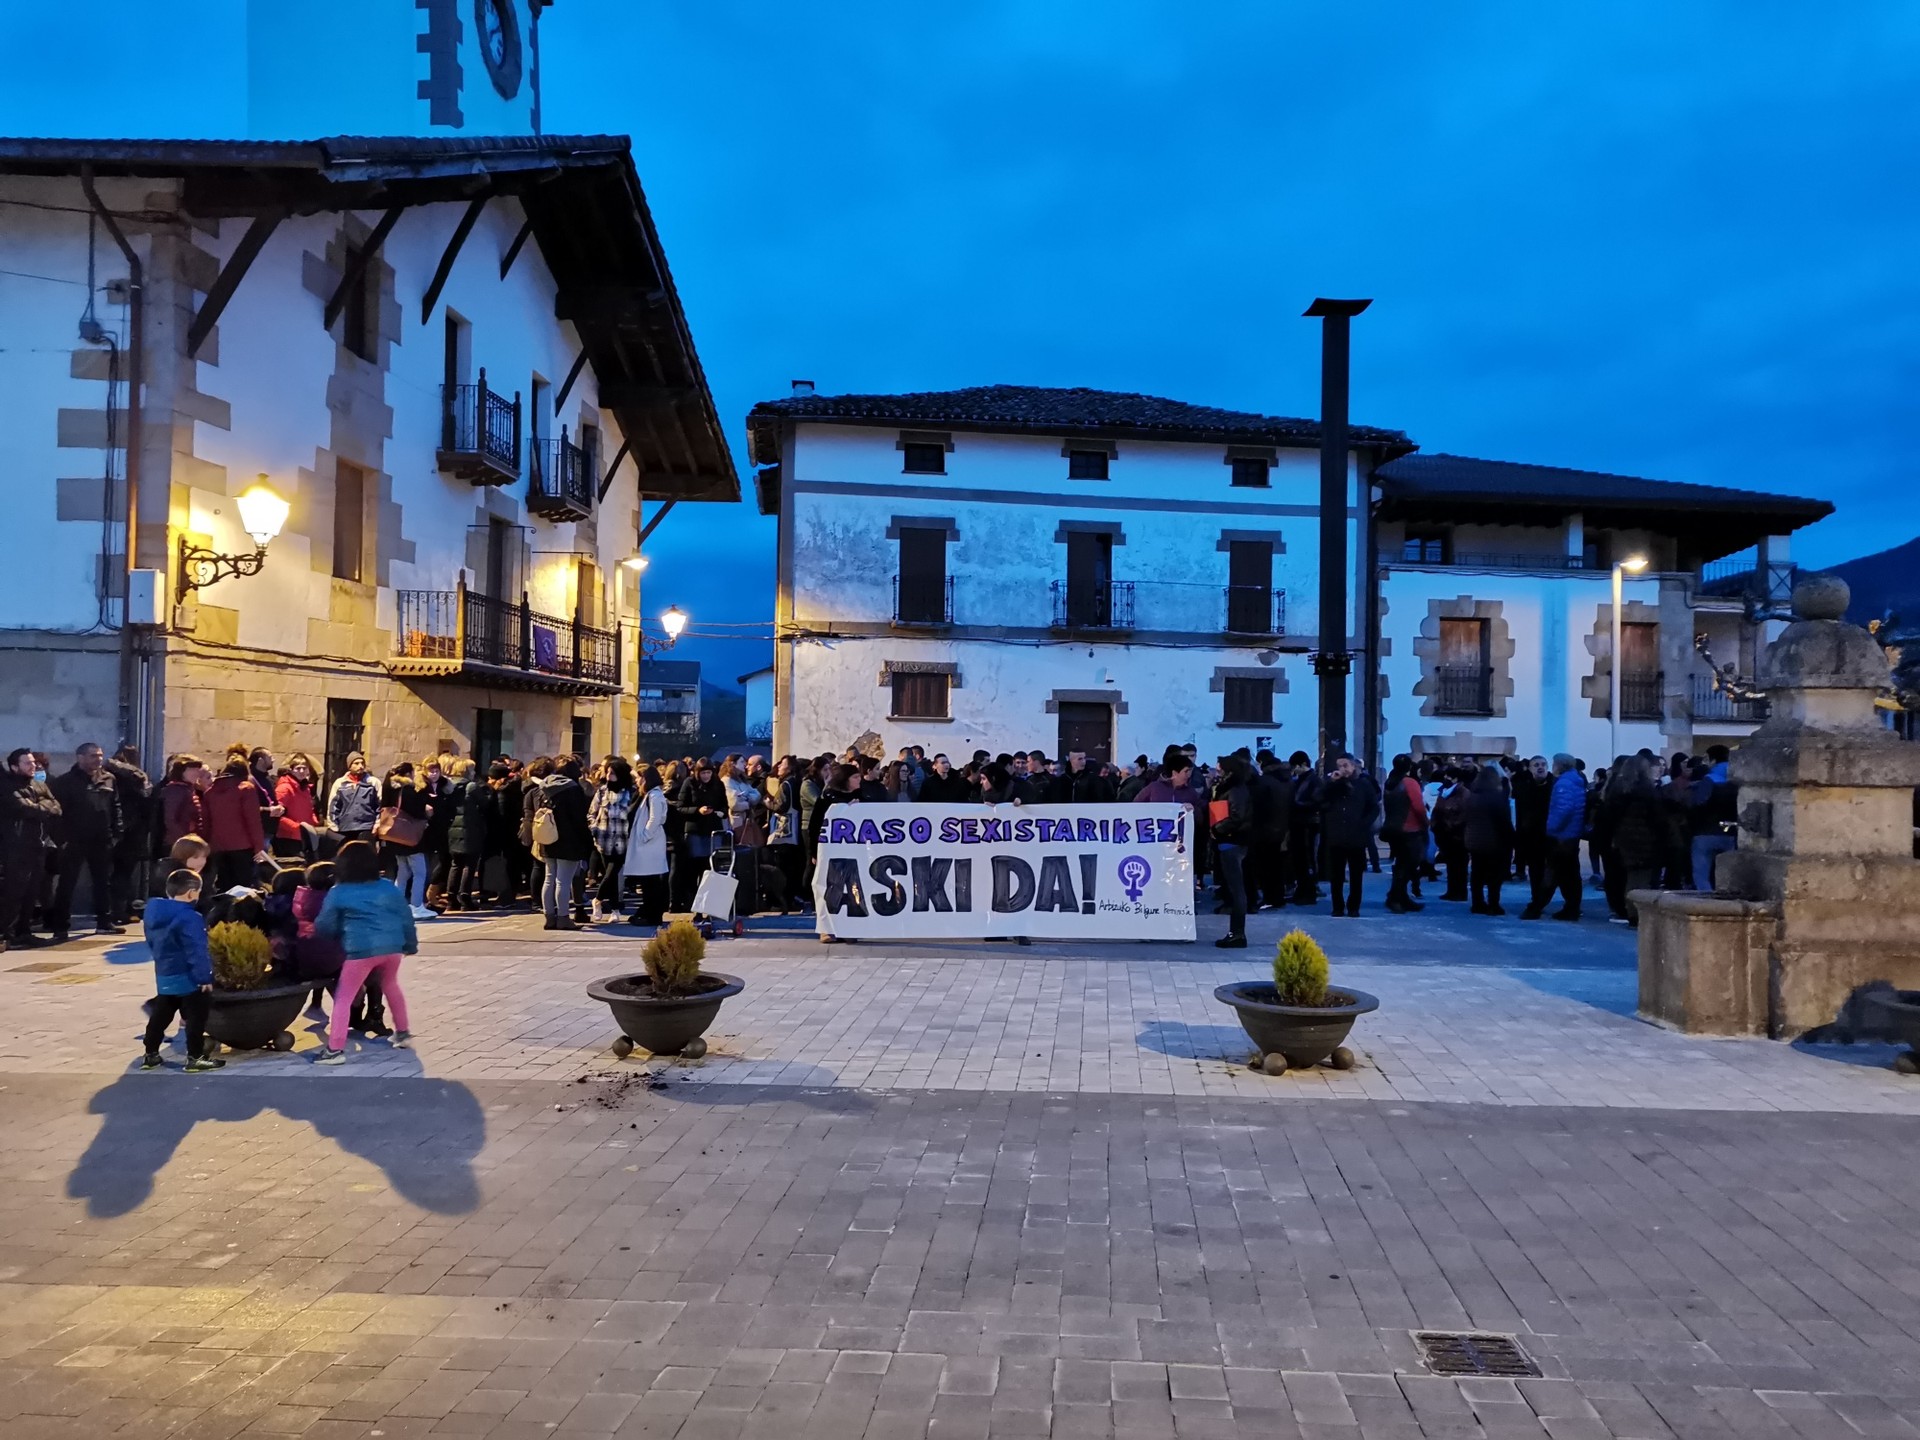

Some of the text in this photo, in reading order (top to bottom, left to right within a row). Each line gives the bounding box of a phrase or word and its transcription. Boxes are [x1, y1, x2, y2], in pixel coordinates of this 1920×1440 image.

[939, 817, 1131, 844] SEXISTARIK
[1135, 811, 1186, 853] EZ!
[824, 854, 1098, 917] ASKI DA!
